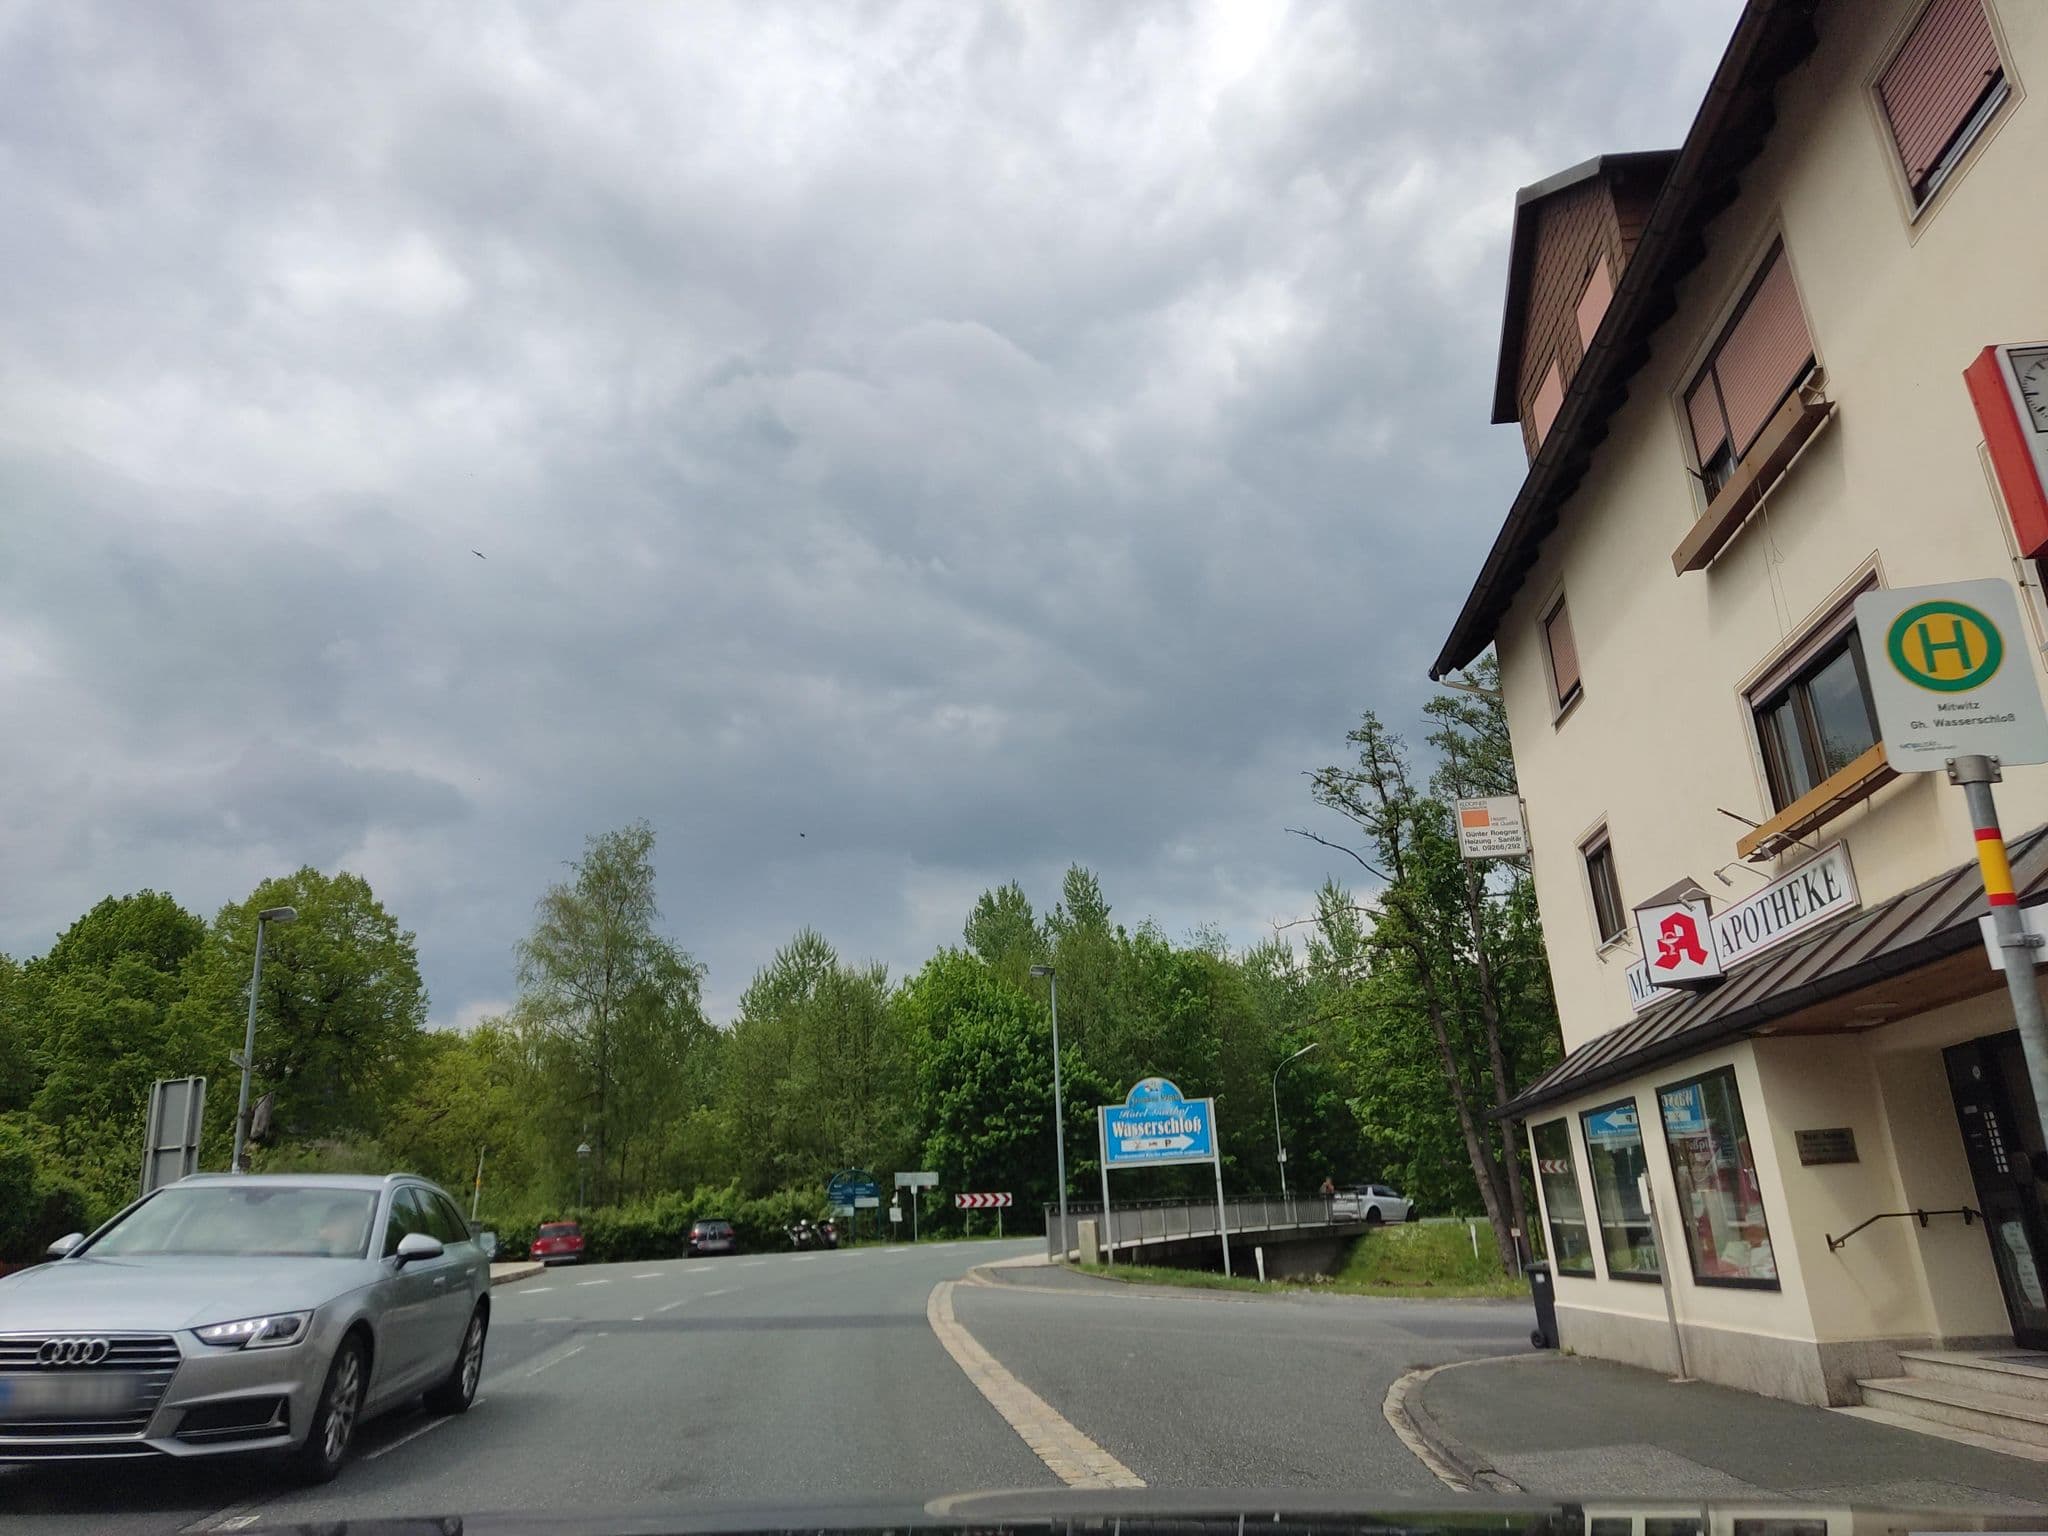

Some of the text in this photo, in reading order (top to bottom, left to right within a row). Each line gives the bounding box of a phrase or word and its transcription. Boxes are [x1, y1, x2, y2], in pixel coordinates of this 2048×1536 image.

[1918, 620, 1973, 673] H
[1937, 702, 1981, 712] Mitwitz
[1910, 713, 2016, 730] Gh. Wasserschloß
[1719, 861, 1843, 958] APOTHEKE
[1112, 1116, 1202, 1138] Wasserschloß
[1165, 1138, 1172, 1148] P
